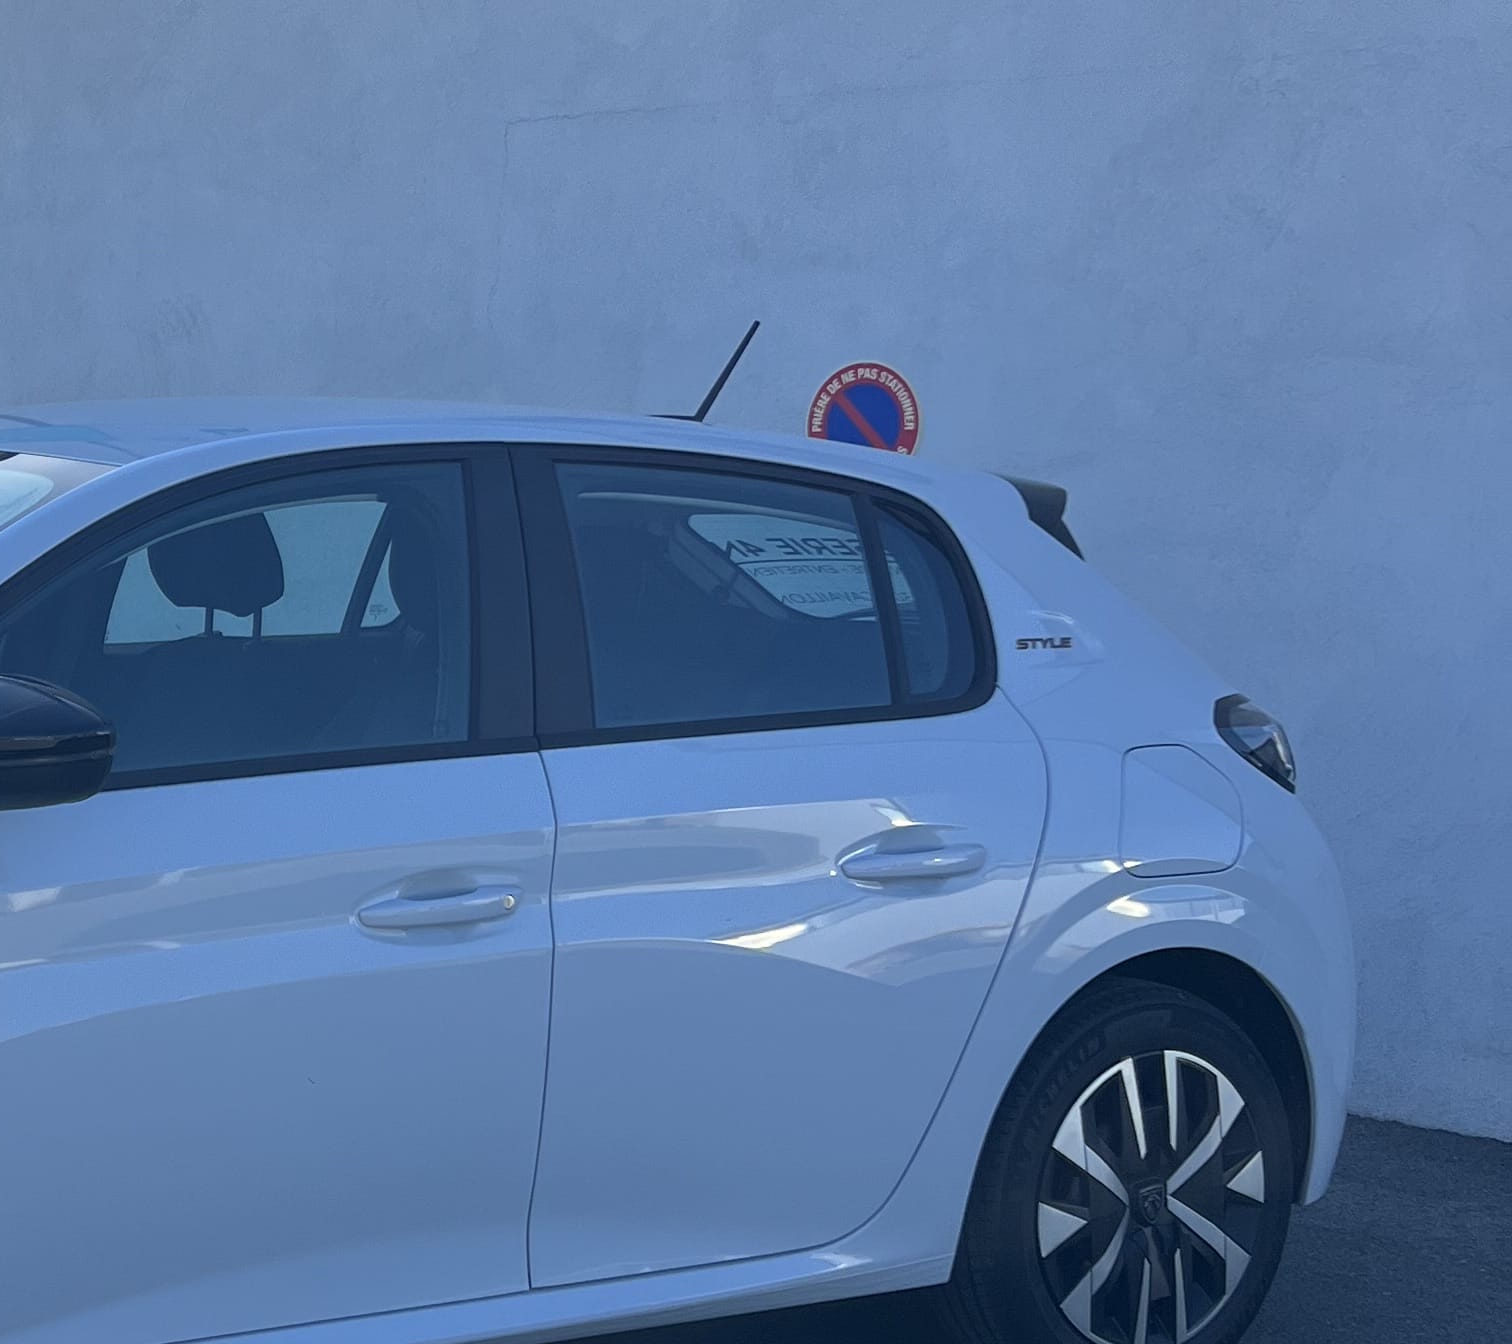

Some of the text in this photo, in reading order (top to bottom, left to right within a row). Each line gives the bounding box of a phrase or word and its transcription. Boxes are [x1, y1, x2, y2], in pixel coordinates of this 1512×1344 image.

[826, 378, 842, 395] DE
[840, 369, 857, 384] NE
[857, 367, 879, 380] PAS
[878, 371, 915, 431] STATIONNER
[1015, 637, 1072, 650] STYLE
